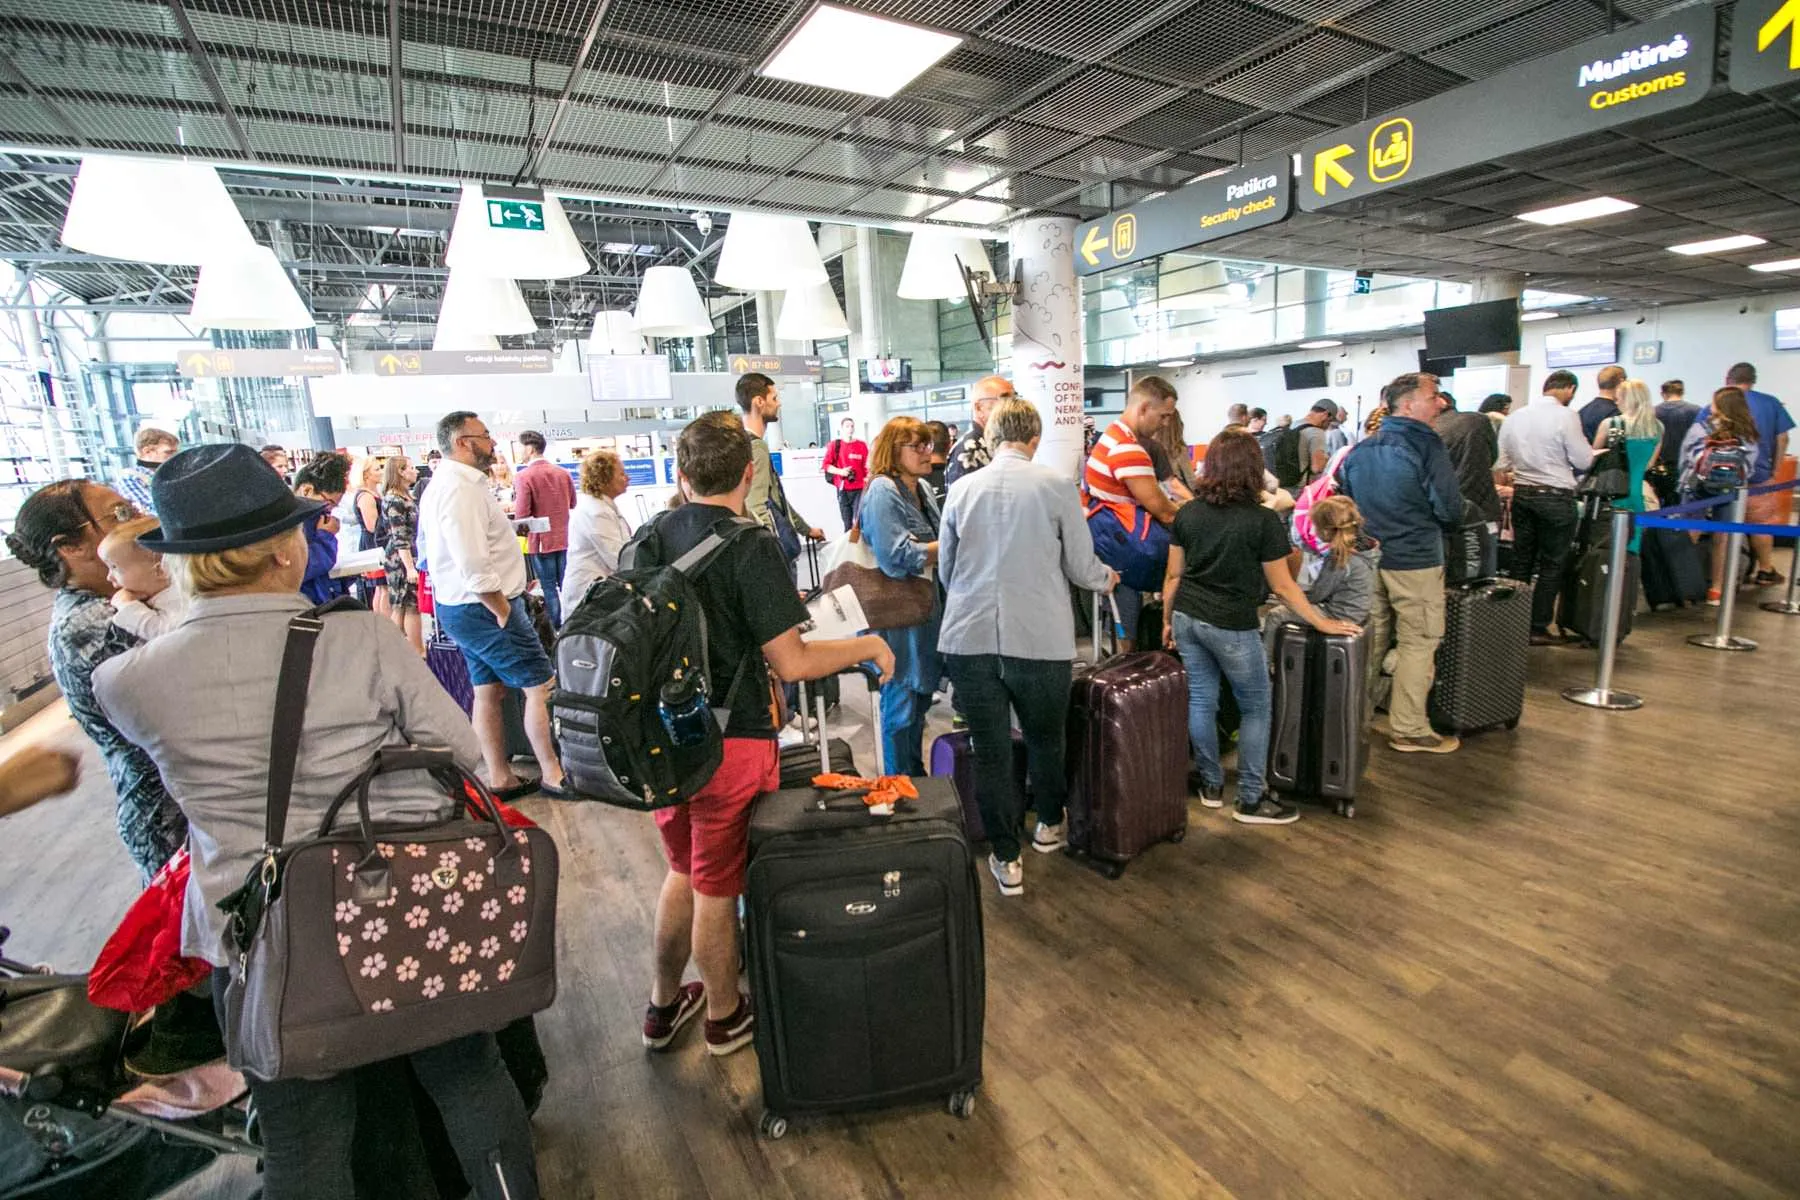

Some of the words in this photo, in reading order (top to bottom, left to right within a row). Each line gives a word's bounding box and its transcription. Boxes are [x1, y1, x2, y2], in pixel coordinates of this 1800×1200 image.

[1578, 34, 1688, 87] Muitinė
[1589, 71, 1686, 110] Customs
[1226, 175, 1278, 202] Patikra
[1200, 207, 1241, 229] Security
[1242, 195, 1276, 215] check
[1635, 345, 1657, 360] 19
[1055, 394, 1069, 403] OF
[1055, 416, 1075, 426] AND
